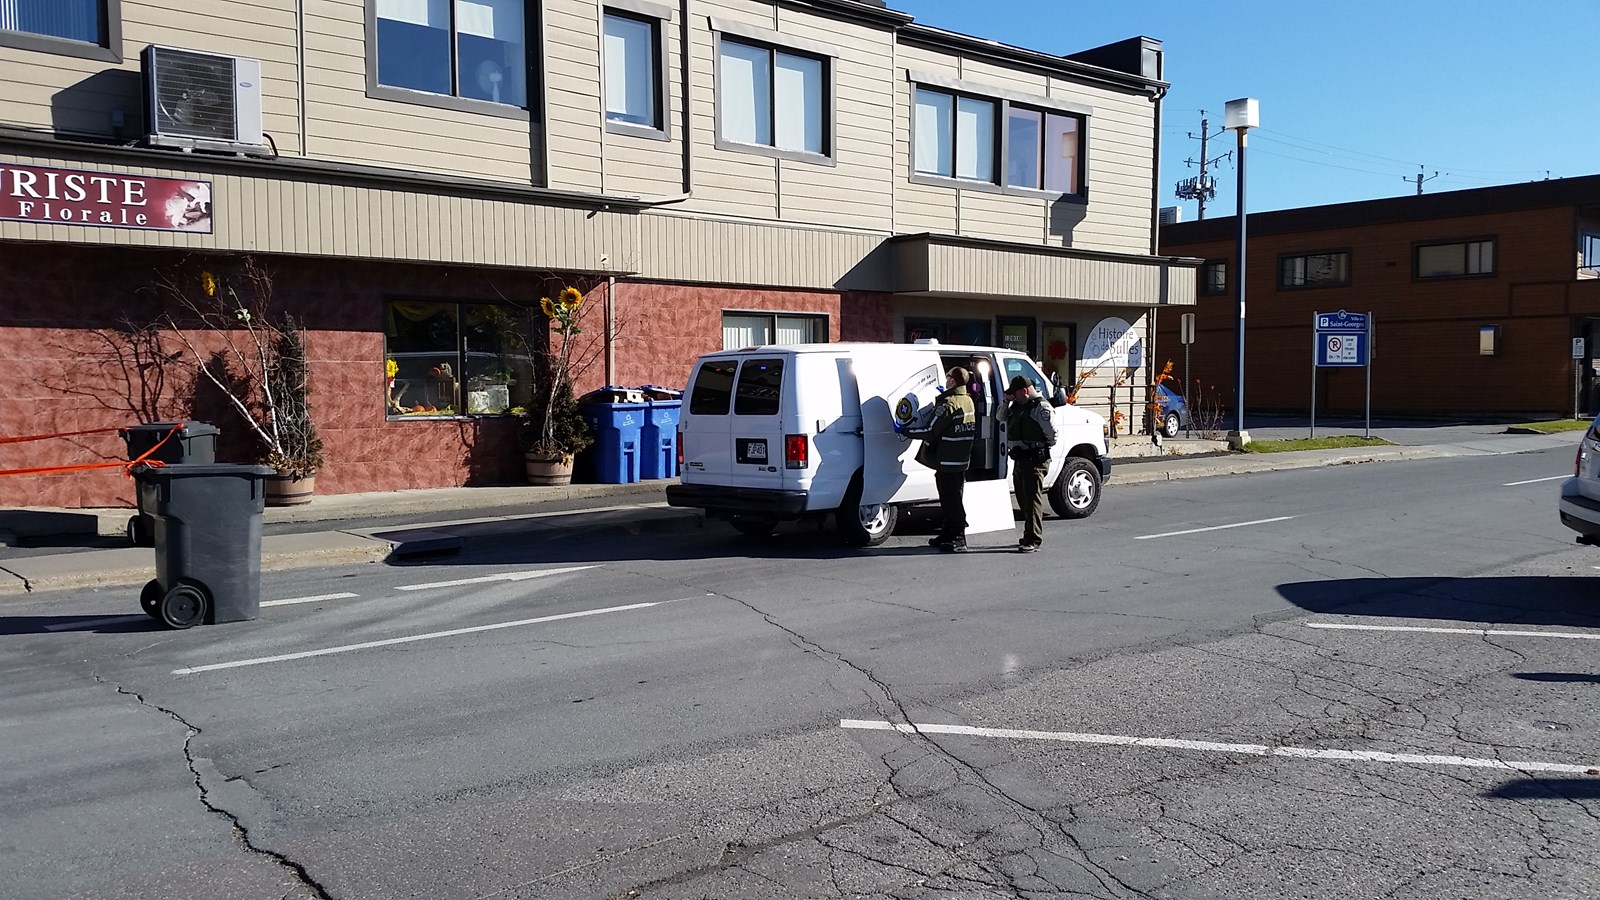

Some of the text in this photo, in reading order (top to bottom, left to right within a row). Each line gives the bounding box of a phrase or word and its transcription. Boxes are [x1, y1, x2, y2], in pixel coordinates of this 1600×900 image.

[0, 168, 148, 206] RISTE
[18, 201, 147, 225] Florale
[1322, 318, 1327, 326] P
[1098, 327, 1134, 340] Histoire
[1110, 340, 1139, 355] Bulles
